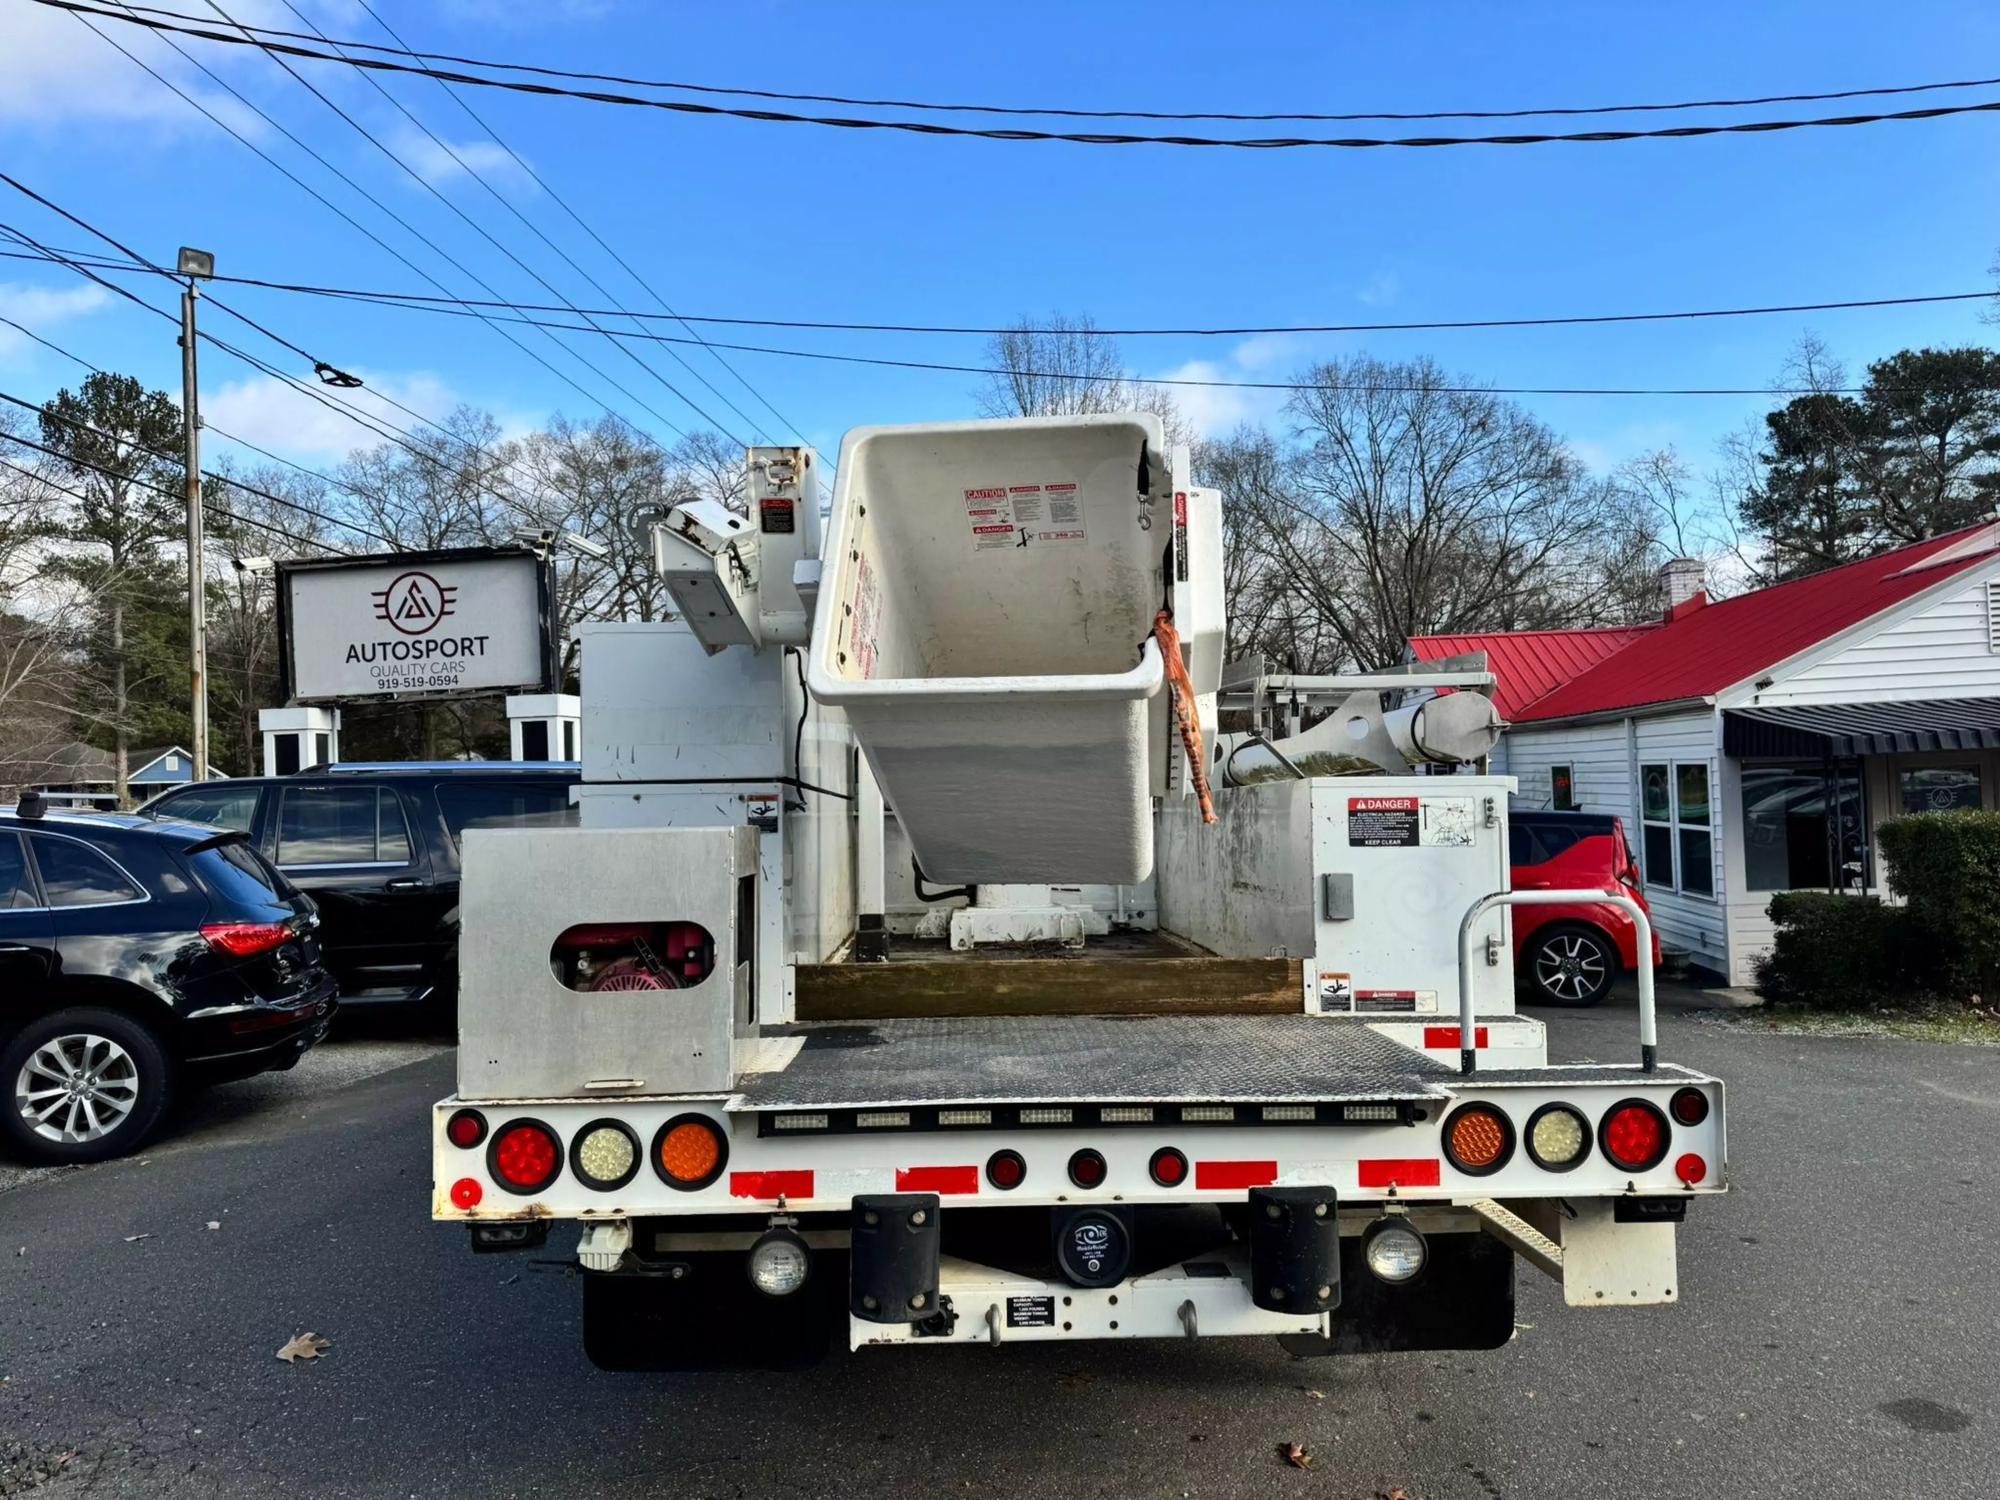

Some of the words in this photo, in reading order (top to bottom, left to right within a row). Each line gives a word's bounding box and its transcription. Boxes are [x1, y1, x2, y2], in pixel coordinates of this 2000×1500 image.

[967, 489, 1004, 499] CAUTION
[1177, 498, 1186, 524] DANGER
[345, 636, 489, 664] AUTOSPORT
[370, 663, 427, 679] QUALITY
[430, 661, 466, 675] CARS
[377, 675, 459, 690] 919-519-0594
[1367, 799, 1411, 809] DANGER
